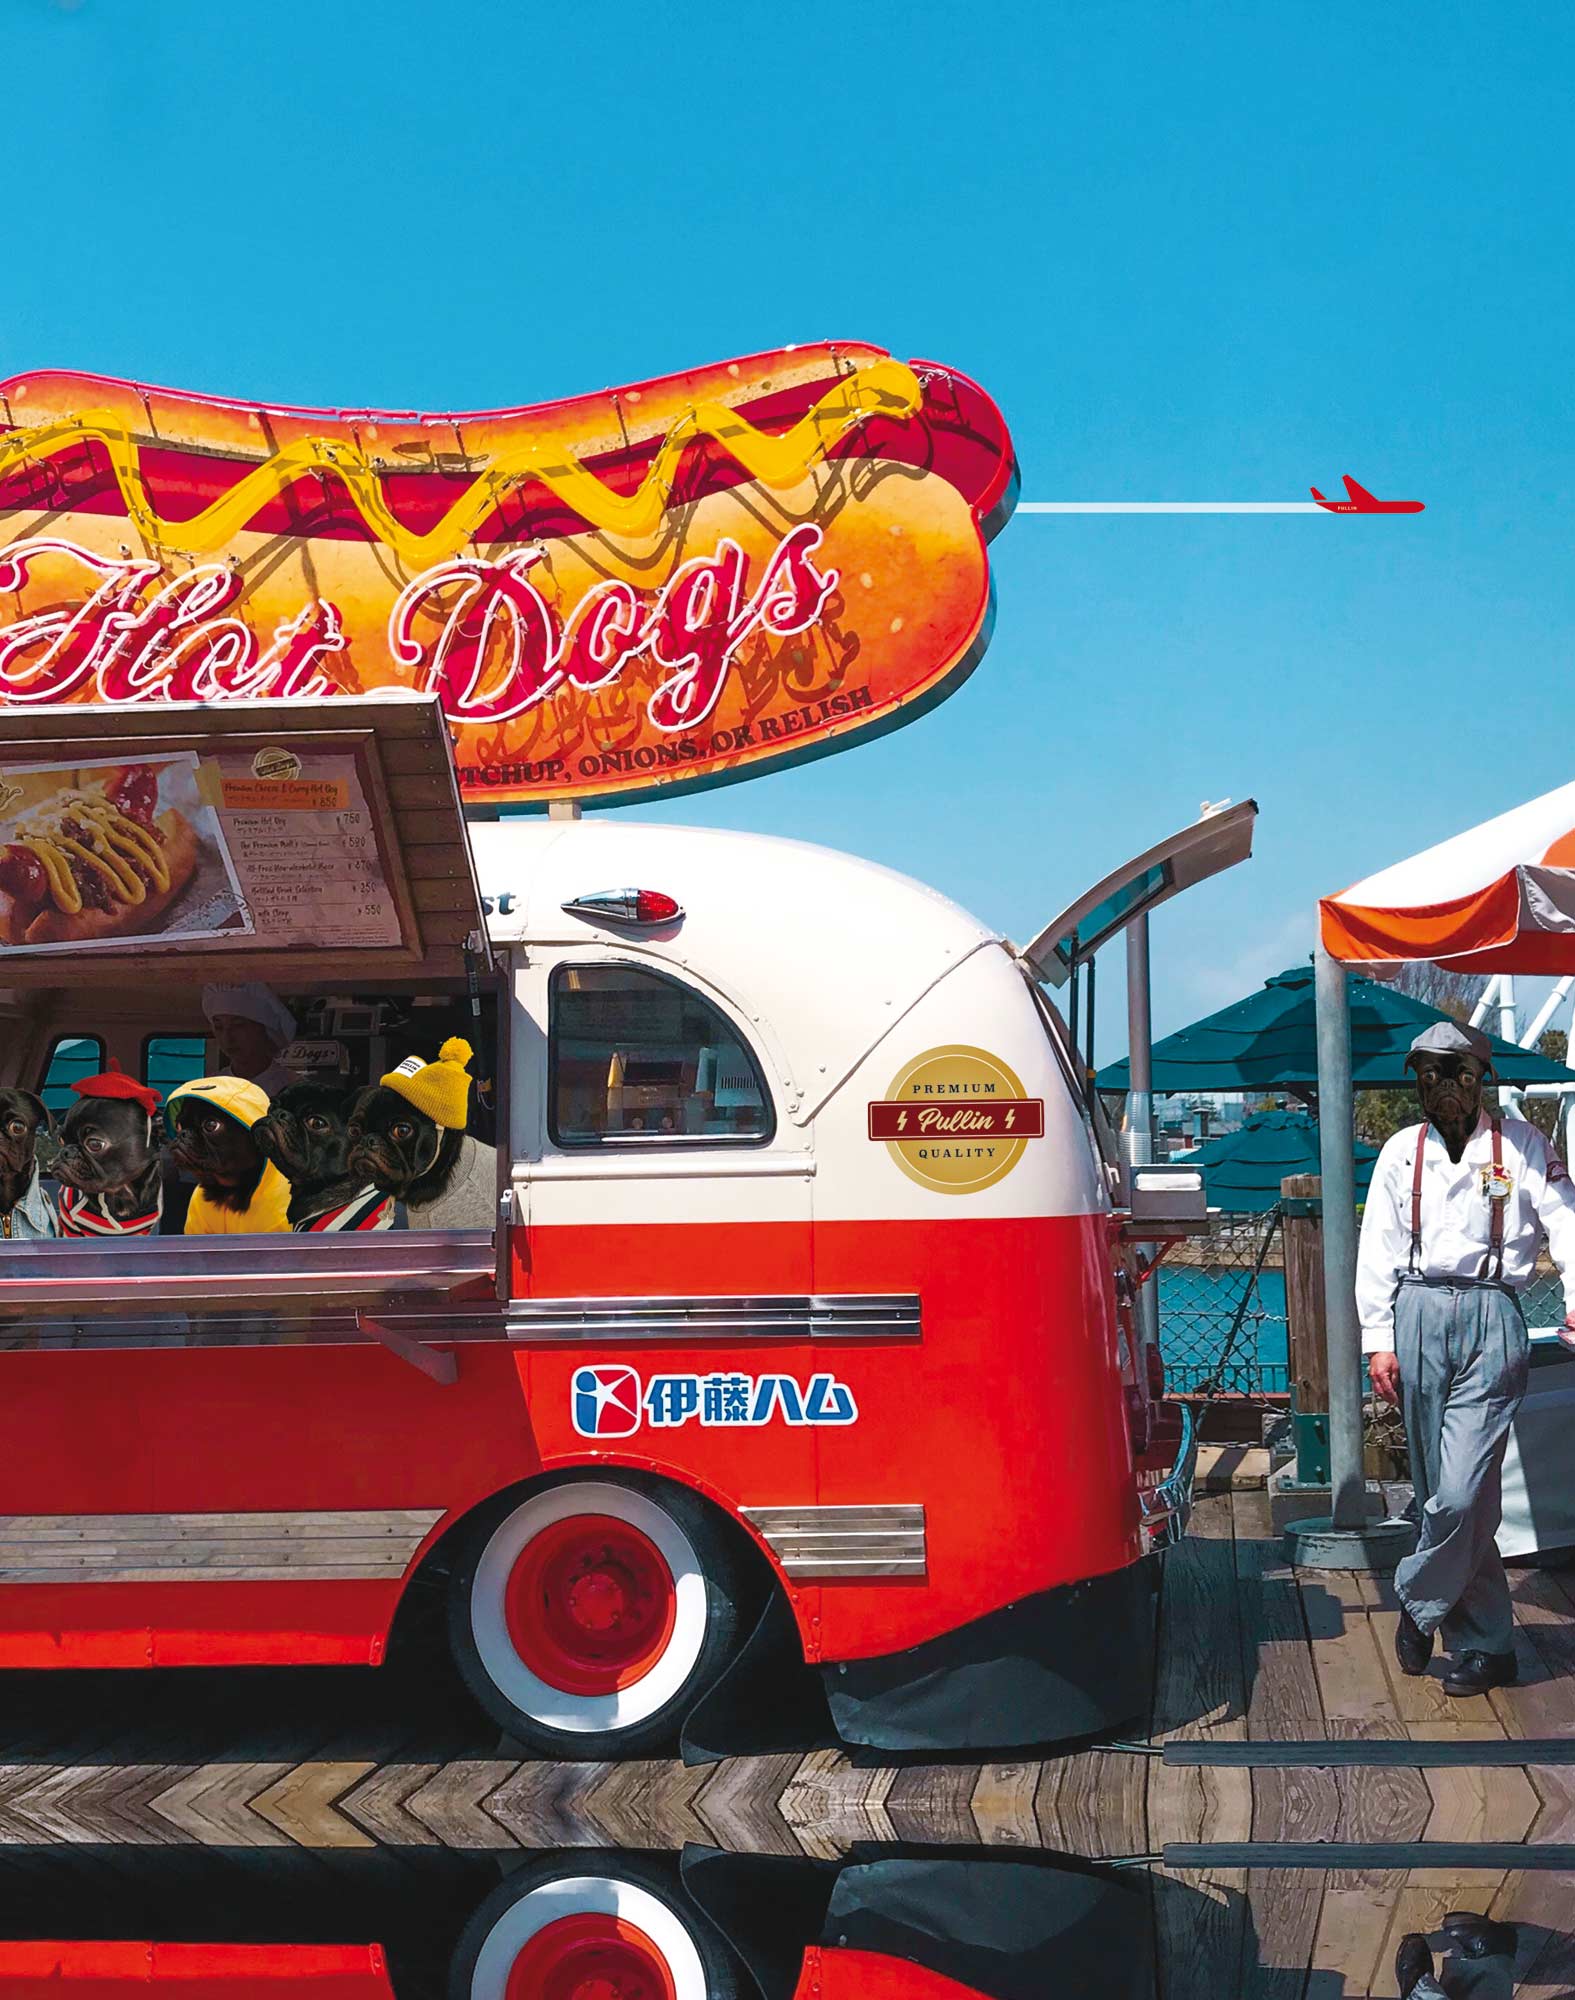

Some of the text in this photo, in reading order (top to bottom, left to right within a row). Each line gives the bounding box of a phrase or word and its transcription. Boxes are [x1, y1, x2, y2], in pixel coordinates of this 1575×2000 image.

[388, 522, 839, 732] Dogs
[455, 684, 876, 787] TCHUP, ONIONS, OR RELISH
[912, 1083, 996, 1094] PREMIUM
[917, 1107, 995, 1133] Pullin
[918, 1148, 997, 1159] QUALITY
[646, 1375, 855, 1424] 伊藤ハム
